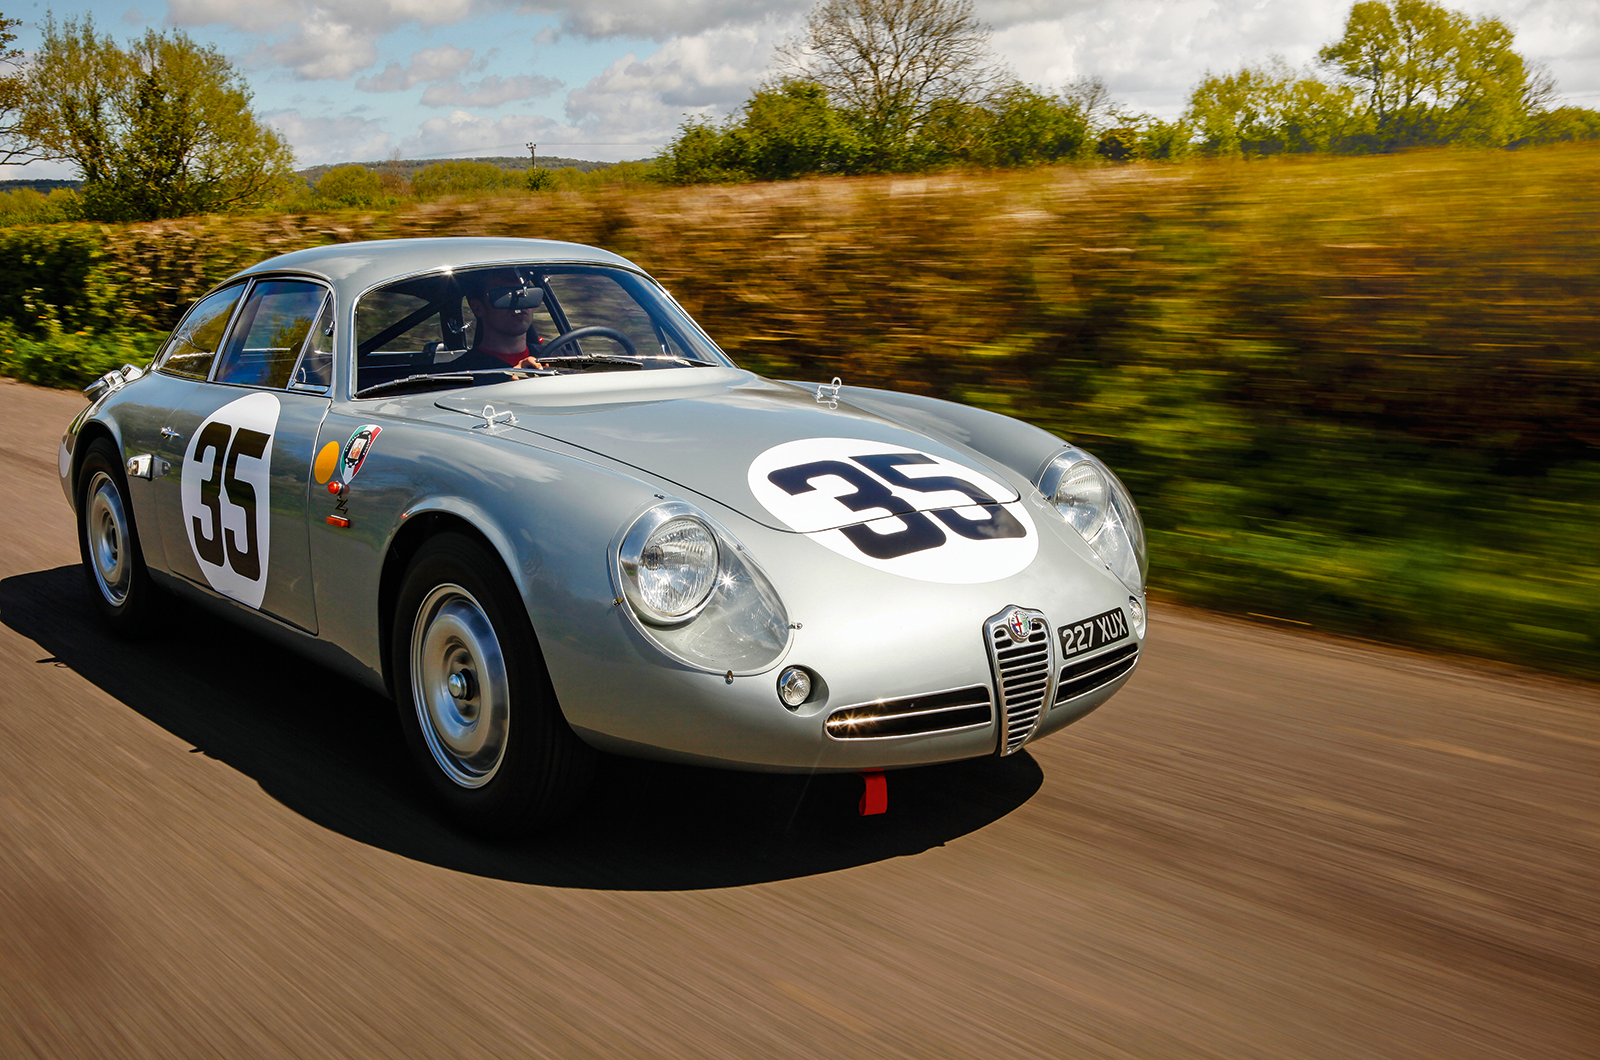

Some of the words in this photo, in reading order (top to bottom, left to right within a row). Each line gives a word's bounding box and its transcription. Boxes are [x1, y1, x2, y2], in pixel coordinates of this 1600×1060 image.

[193, 422, 271, 581] 35
[768, 453, 1027, 559] 35
[1063, 622, 1094, 655] 227
[1097, 611, 1127, 643] XUX
